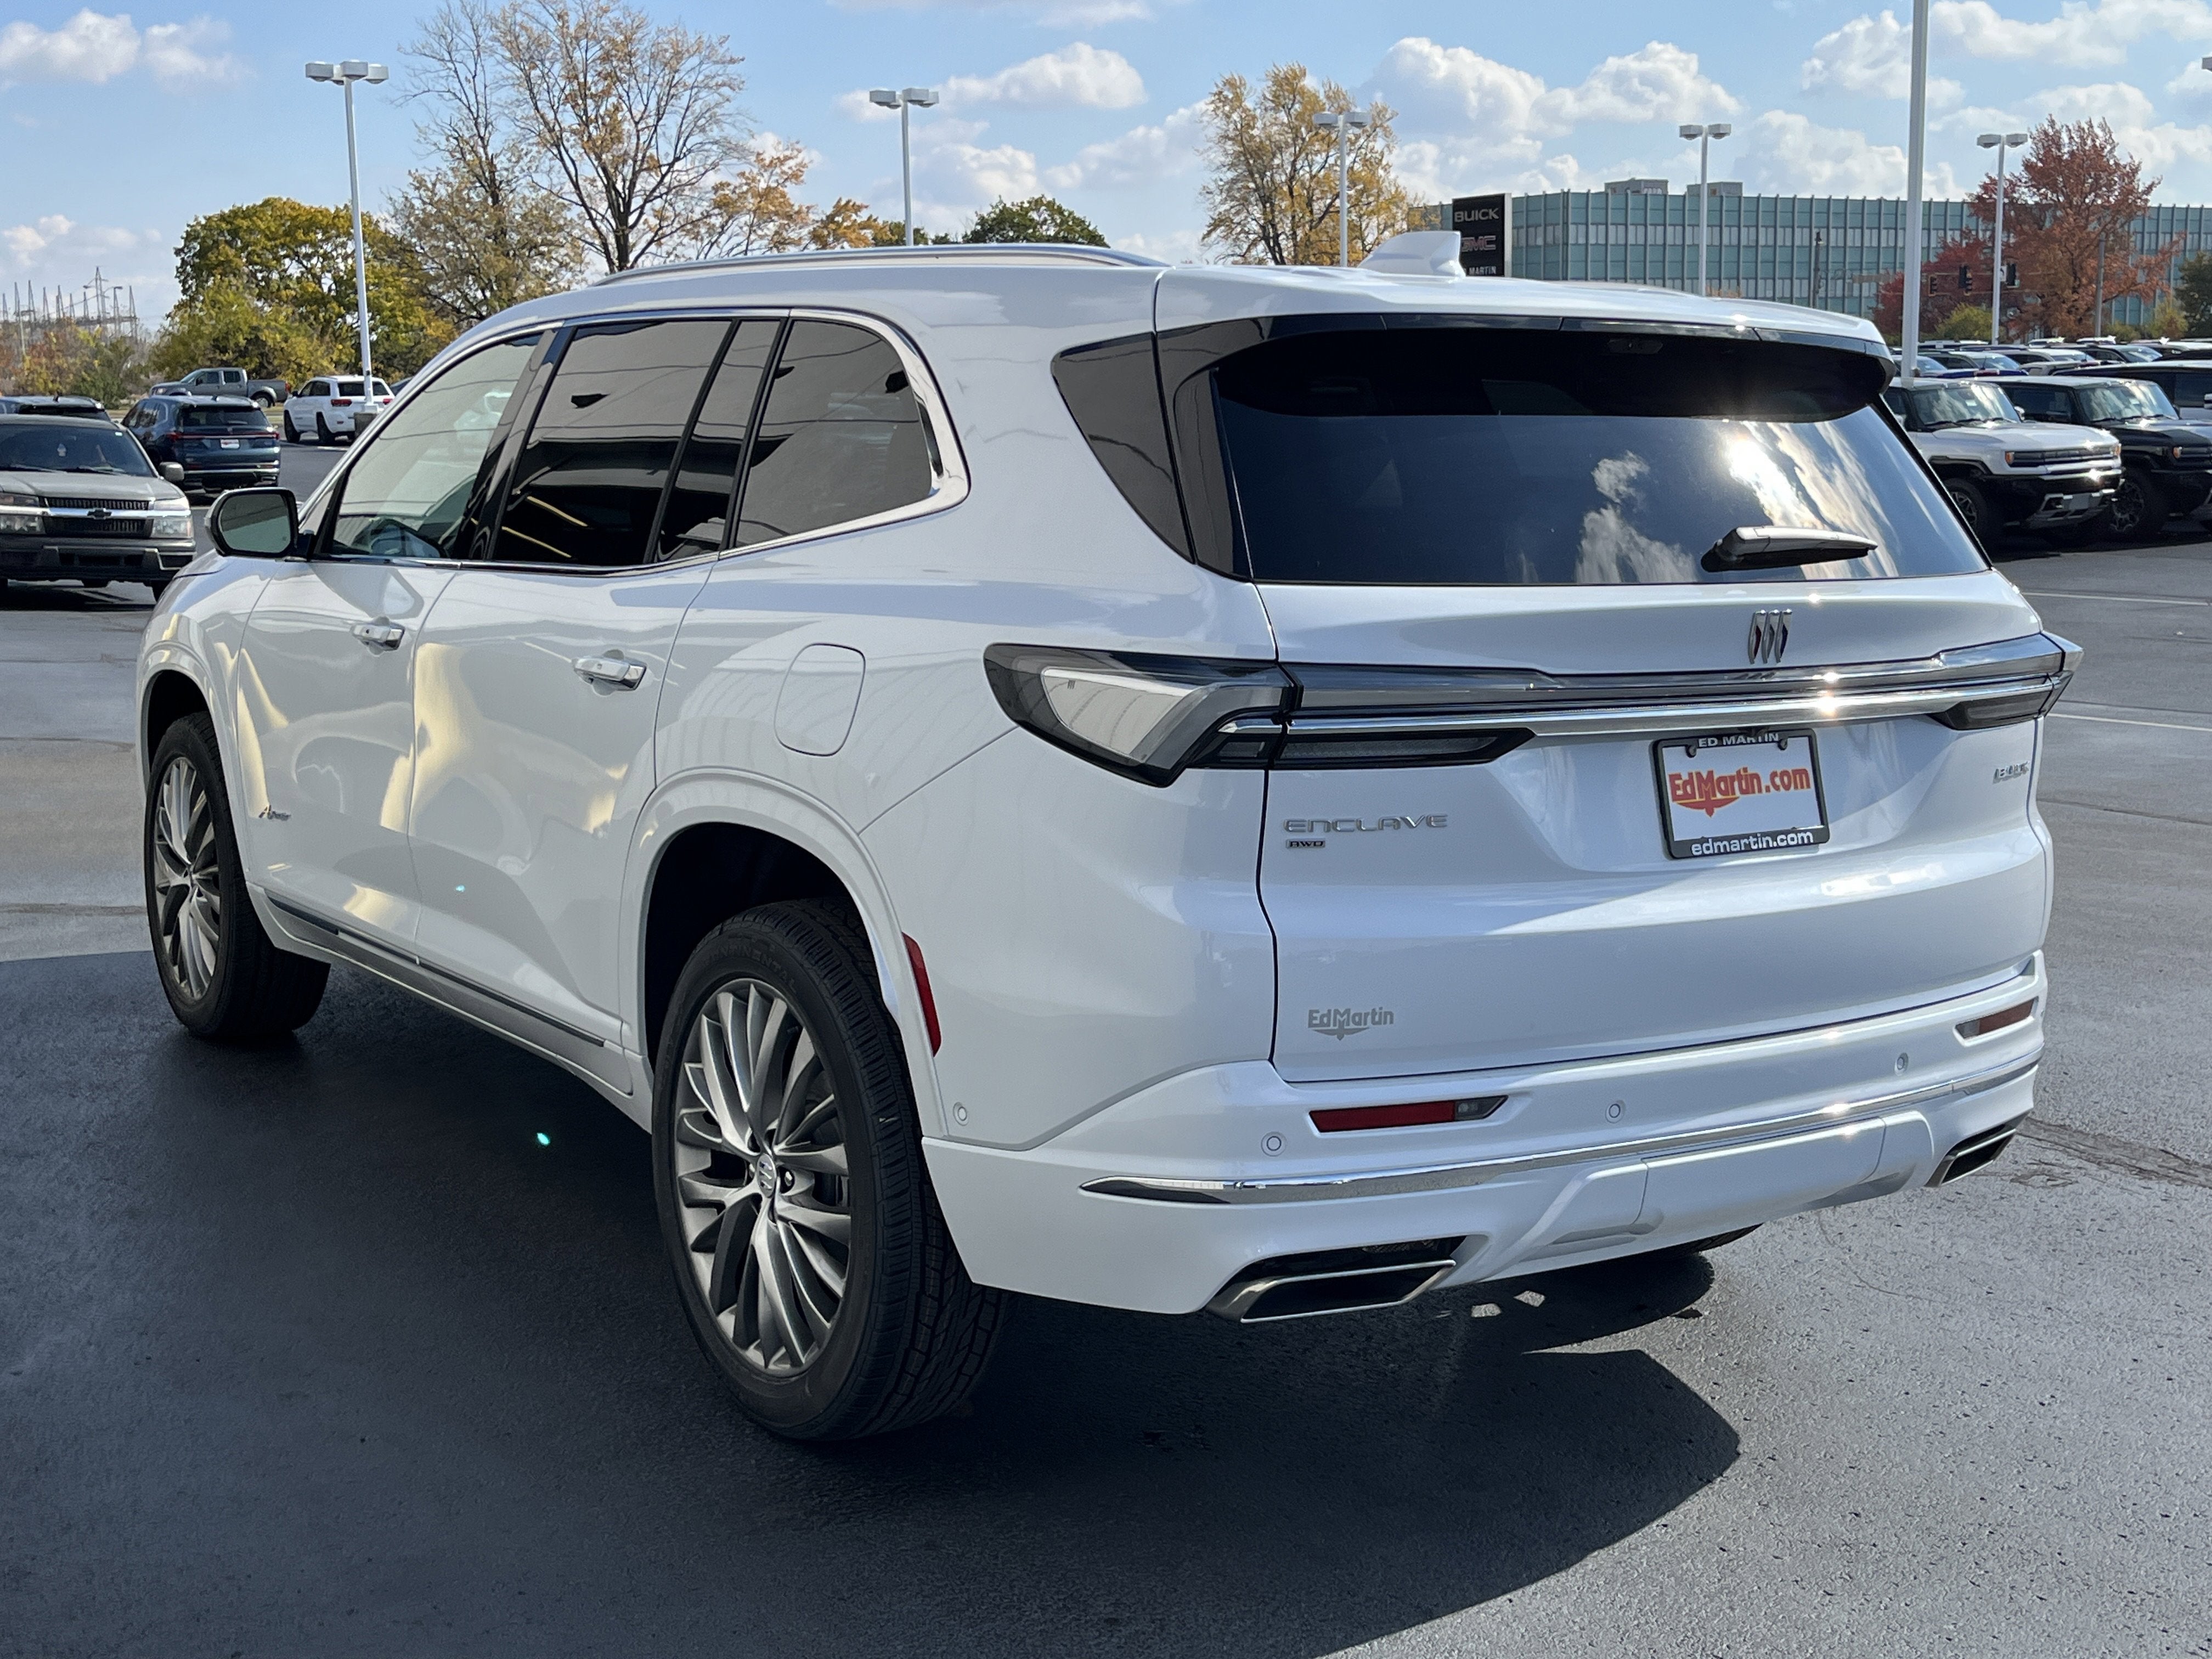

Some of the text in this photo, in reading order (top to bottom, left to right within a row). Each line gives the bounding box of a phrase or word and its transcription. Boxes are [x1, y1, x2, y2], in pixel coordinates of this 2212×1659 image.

[1454, 208, 1499, 222] BUICK
[1461, 235, 1497, 252] GMC
[1698, 737, 1718, 747] ED
[1284, 814, 1448, 833] ENCLAVE
[1289, 839, 1324, 848] AWD
[1691, 831, 1814, 856] edmartin.com
[1307, 1007, 1395, 1029] EdMartin
